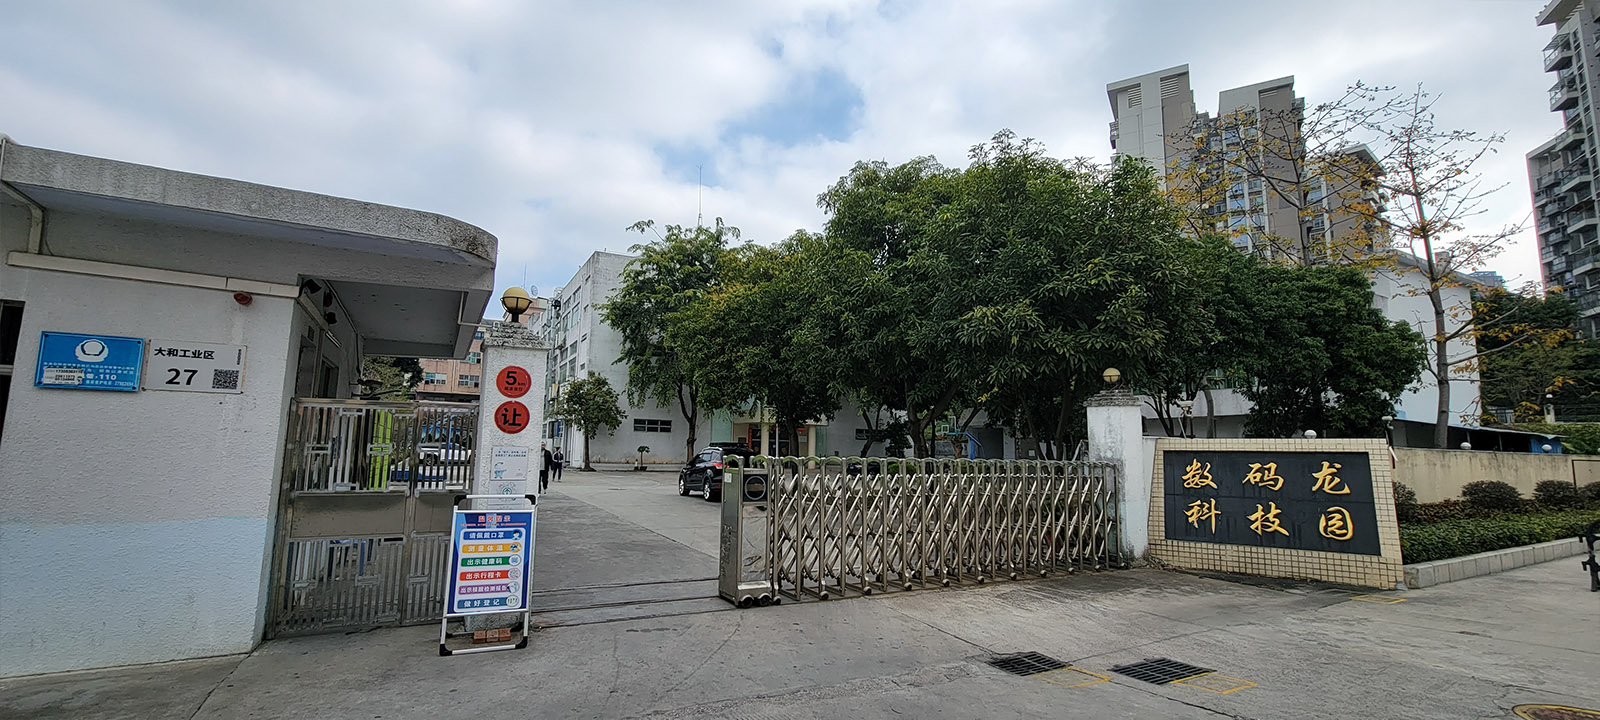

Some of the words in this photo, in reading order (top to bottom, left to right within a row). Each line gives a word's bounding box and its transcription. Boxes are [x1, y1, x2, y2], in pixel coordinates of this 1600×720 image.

[154, 347, 215, 360] 大和工业区
[165, 368, 198, 385] 27
[505, 371, 517, 385] 5
[501, 408, 521, 426] 让
[1182, 458, 1351, 495] 数码龙
[1183, 498, 1354, 541] 科技园
[467, 558, 503, 566] 出示健康码
[466, 571, 502, 580] 出示行程卡
[464, 599, 500, 607] 做好登记
